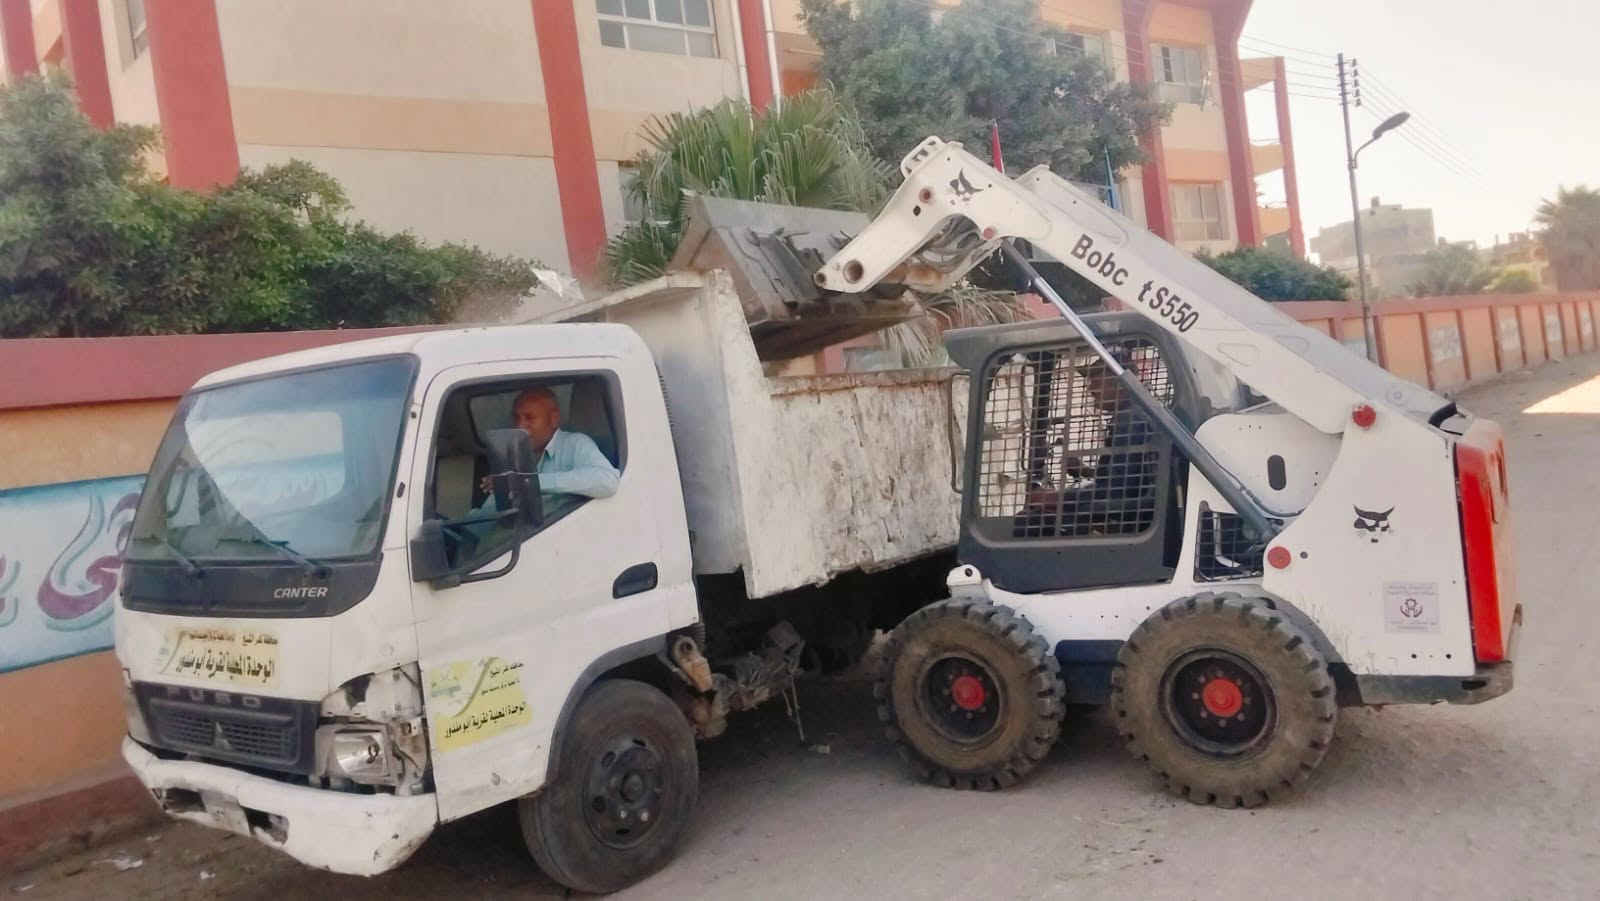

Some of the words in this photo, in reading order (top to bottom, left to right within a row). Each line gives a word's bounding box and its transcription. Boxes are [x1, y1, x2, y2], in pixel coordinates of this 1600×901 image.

[273, 586, 329, 599] CANTER
[226, 651, 246, 680] المحلية
[247, 655, 275, 683] الوحدة
